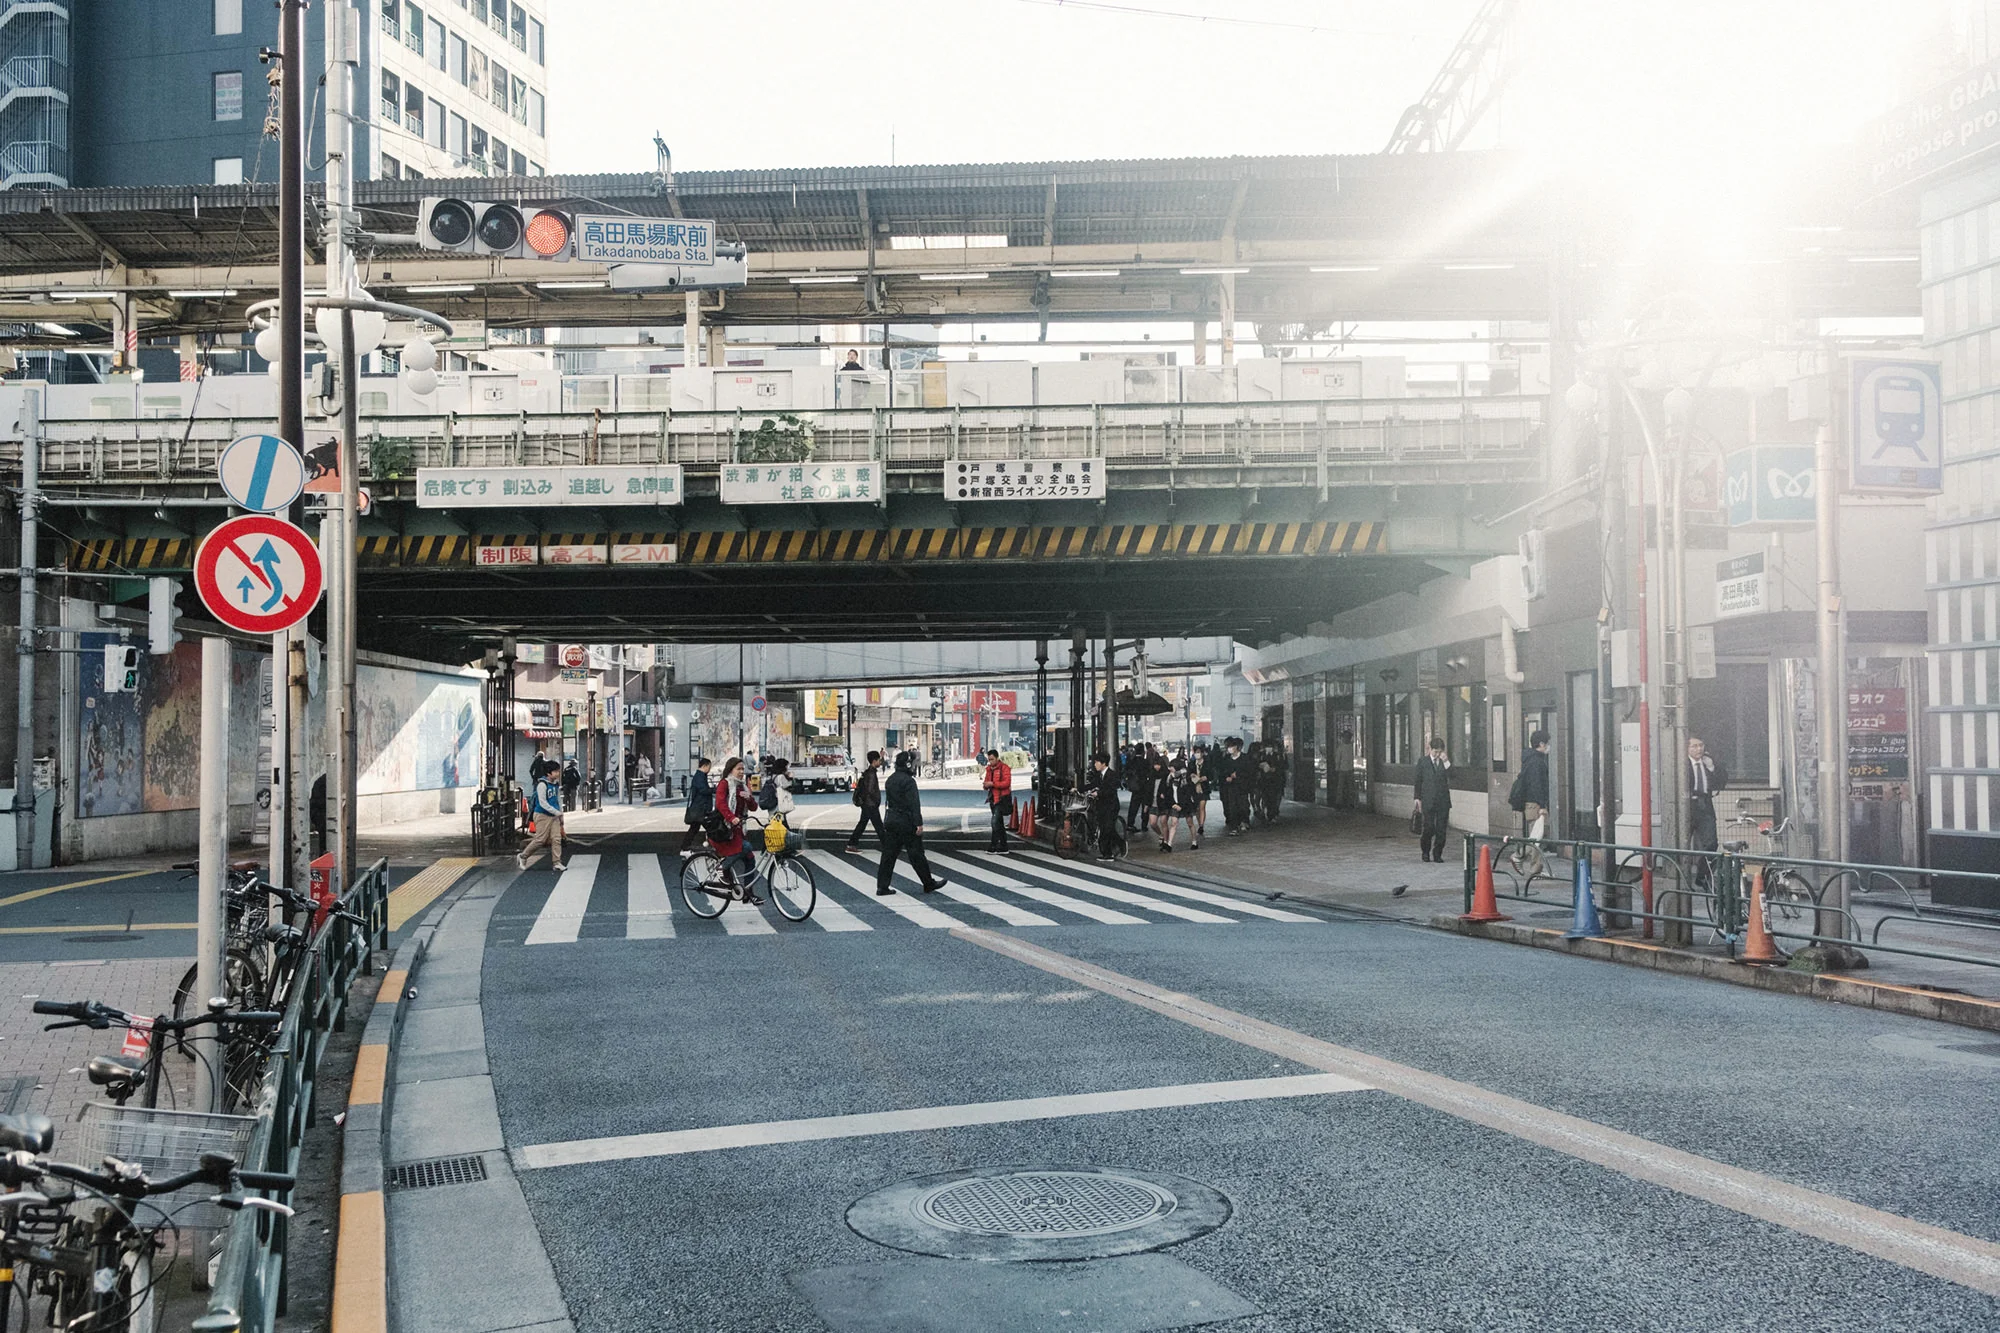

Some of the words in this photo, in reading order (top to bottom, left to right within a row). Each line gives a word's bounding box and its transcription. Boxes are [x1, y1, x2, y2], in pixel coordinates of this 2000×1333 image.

[1960, 109, 2000, 147] pro
[584, 221, 708, 248] 高田馬場駅前
[585, 244, 681, 260] Takadanobaba
[685, 247, 709, 261] Sta.
[970, 462, 1091, 473] 戸塚警察署
[726, 467, 870, 483] 渋滞が招く迷惑
[970, 474, 1092, 486] 戸塚交通安全協会
[423, 479, 491, 497] 危険です
[503, 478, 553, 496] 割込み
[568, 478, 614, 495] 追越し
[626, 477, 675, 494] 急停車
[781, 484, 870, 500] 社会の損失
[970, 485, 1092, 498] 新宿西ライオンズクラブ
[481, 547, 533, 564] 制限
[567, 700, 573, 709] 5
[1848, 693, 1885, 705] ラオケ
[1848, 746, 1906, 754] ターネット&コミック
[1848, 763, 1889, 776] くりドンキー
